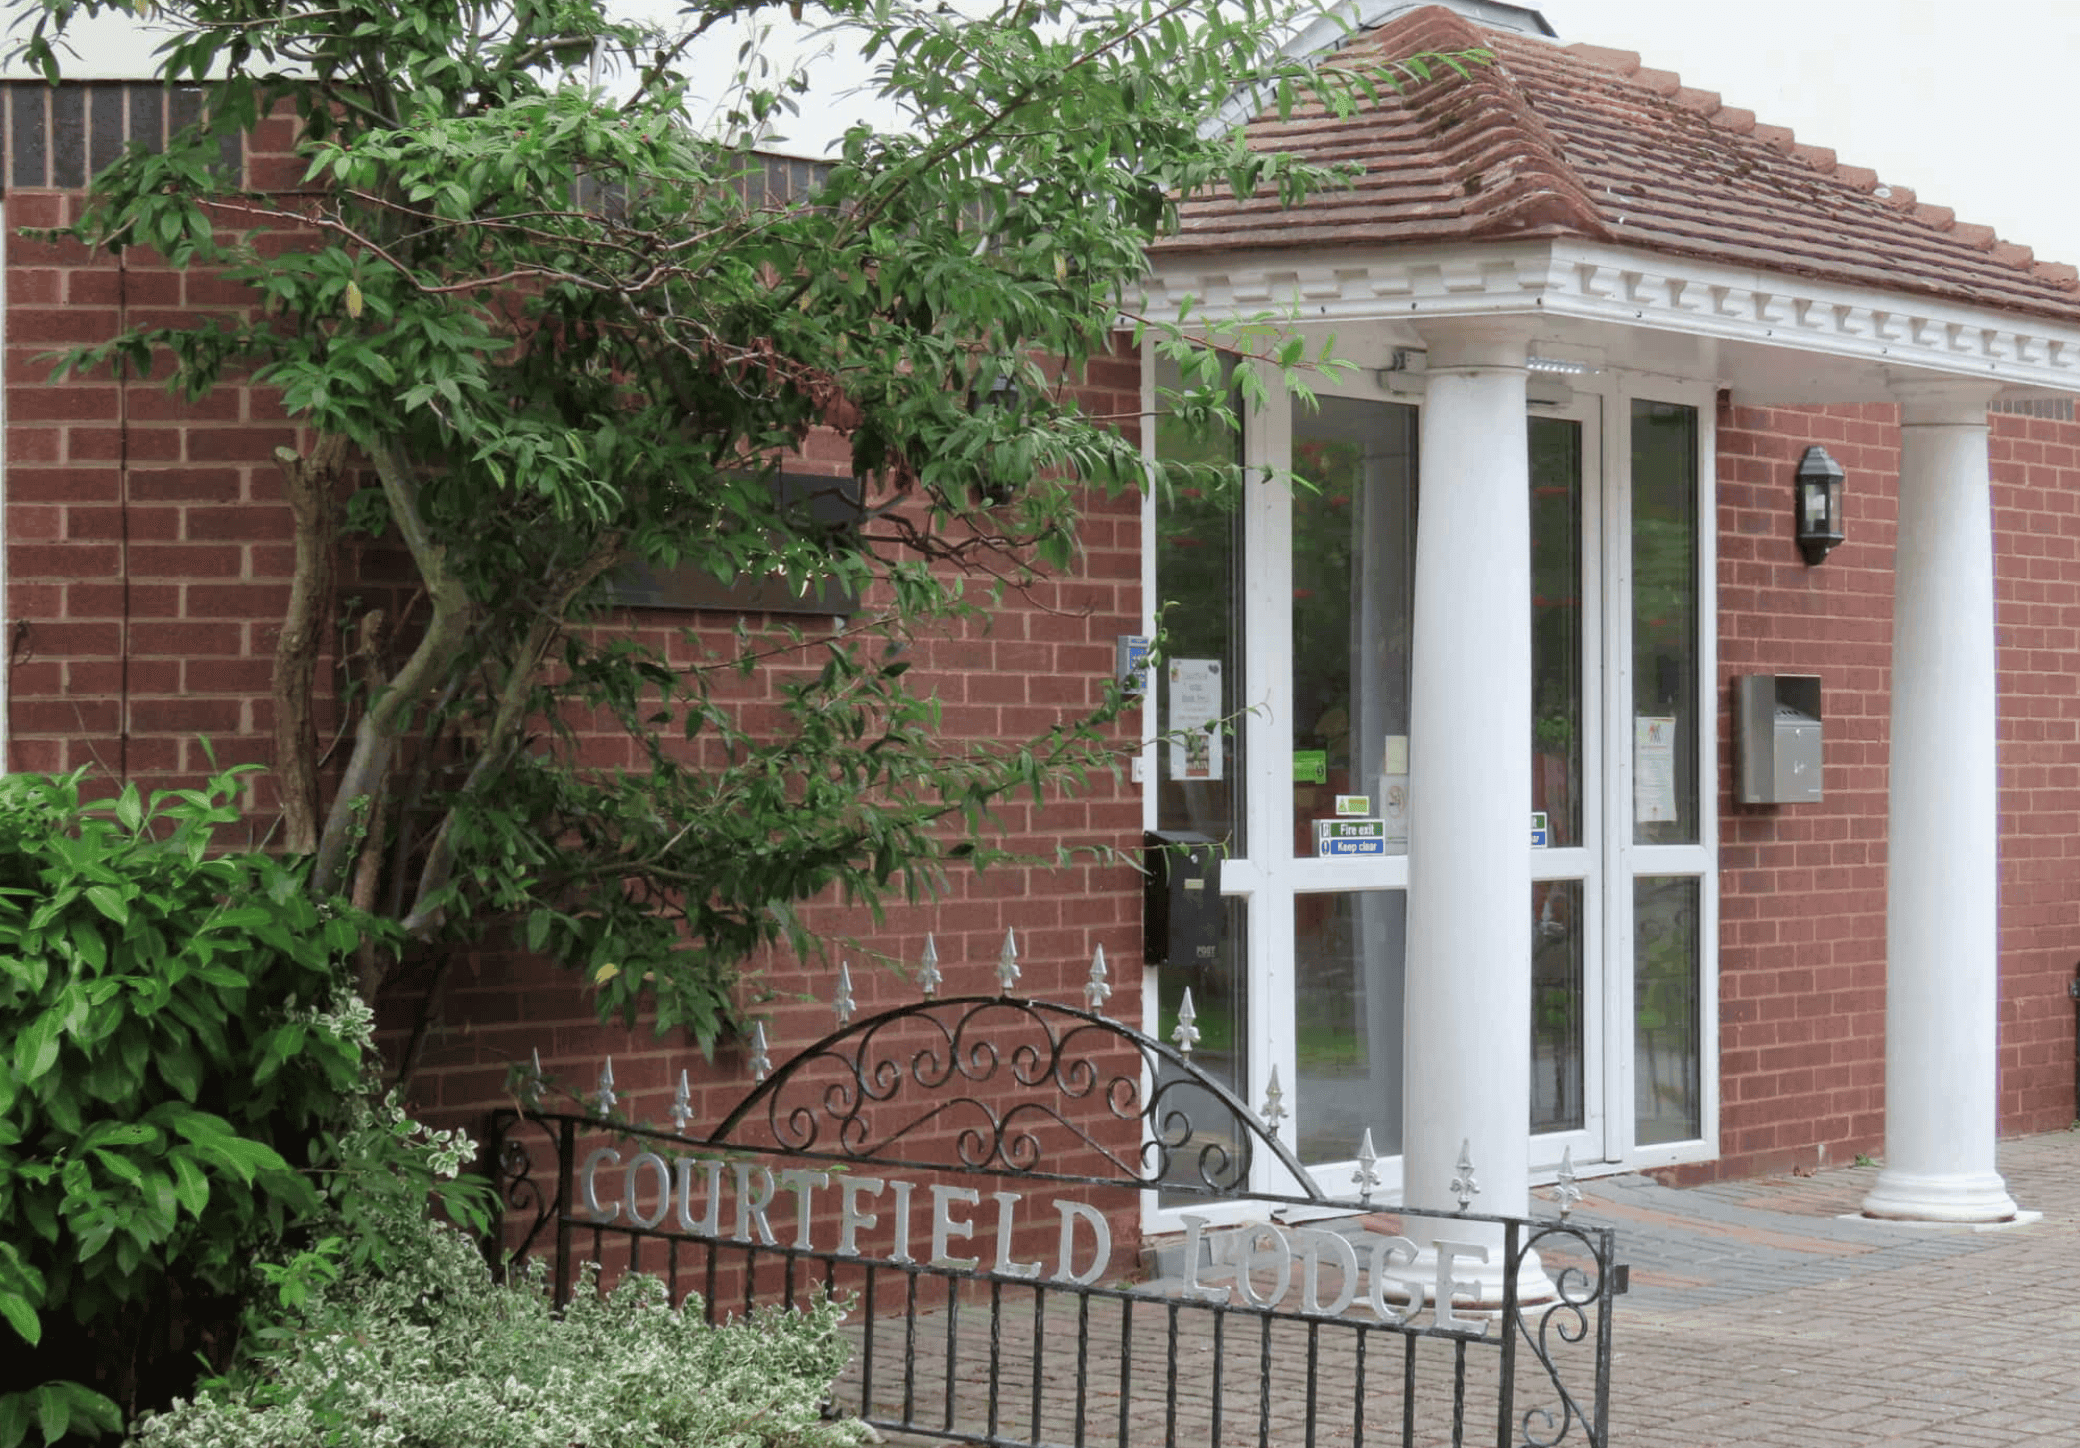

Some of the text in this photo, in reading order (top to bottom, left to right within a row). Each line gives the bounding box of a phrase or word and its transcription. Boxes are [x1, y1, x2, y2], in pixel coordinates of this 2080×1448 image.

[1340, 822, 1375, 836] Fire exit
[1337, 839, 1357, 853] Keep
[1358, 840, 1378, 852] clear
[1196, 945, 1216, 957] POST
[581, 1147, 1489, 1337] COURTFIELD LODGE
